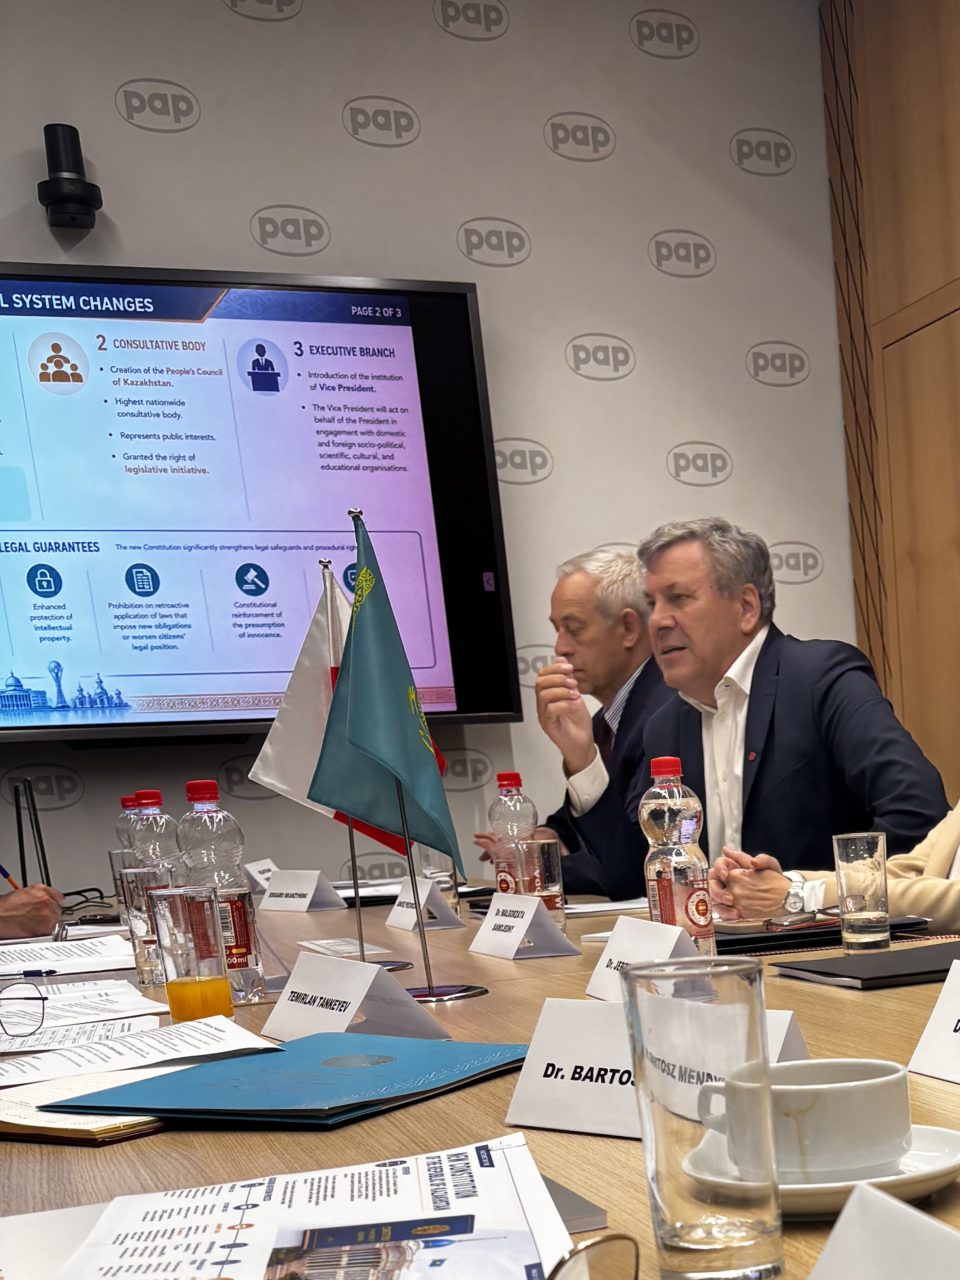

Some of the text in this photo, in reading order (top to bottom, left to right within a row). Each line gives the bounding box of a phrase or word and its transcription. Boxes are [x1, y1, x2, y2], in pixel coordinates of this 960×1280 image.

[440, 0, 503, 32] pap
[635, 20, 695, 51] pap
[123, 89, 194, 124] pap
[350, 106, 414, 139] pap
[550, 122, 611, 154] pap
[735, 138, 792, 169] pap
[258, 216, 324, 247] pap
[463, 228, 526, 259] pap
[654, 240, 712, 270] pap
[12, 293, 76, 310] SYSTEM
[80, 296, 154, 312] CHANGES
[351, 305, 402, 318] PAGE 2 OF 3
[96, 334, 207, 352] 2 CONSULTATIVE BODY
[293, 340, 396, 359] 3 EXECUTIVE BRANCH
[572, 344, 631, 373] pap
[751, 351, 806, 379] pap
[110, 365, 223, 377] Creation of the People's Council
[308, 371, 404, 382] Introduction of the institution
[112, 378, 174, 388] of Kazakhstan.
[310, 383, 377, 393] of Vice President.
[115, 397, 186, 407] Highest nationwide
[312, 403, 326, 412] The
[326, 404, 342, 413] Vice
[343, 404, 375, 413] President
[375, 405, 388, 413] will
[388, 406, 399, 414] act
[117, 410, 183, 421] consultative body.
[314, 416, 335, 424] behalf
[336, 416, 345, 424] of
[345, 417, 357, 425] the
[358, 417, 390, 425] President
[120, 431, 217, 442] Represents public interests.
[315, 429, 406, 438] engagement with domestic
[317, 440, 331, 448] and
[331, 440, 357, 449] foreign
[122, 452, 196, 464] Granted the right of
[381, 453, 396, 461] and
[125, 465, 210, 475] legislative initiative.
[320, 463, 361, 472] educational
[672, 452, 729, 479] pap
[0, 541, 100, 553] LEGAL GUARANTEES
[115, 543, 128, 551] The
[143, 543, 182, 551] Constitution
[182, 543, 218, 553] significantly
[219, 544, 254, 552] strengthens
[254, 544, 269, 552] legal
[33, 603, 66, 611] Enhanced
[233, 601, 278, 609] Constitutional
[29, 614, 65, 622] protection
[113, 612, 150, 621] application
[112, 623, 137, 631] impose
[154, 622, 192, 631] obligations
[39, 635, 72, 643] property.
[131, 643, 149, 652] legal
[287, 990, 352, 1014] TEMIRLAN TANKEYEV
[543, 1062, 565, 1080] Dr.
